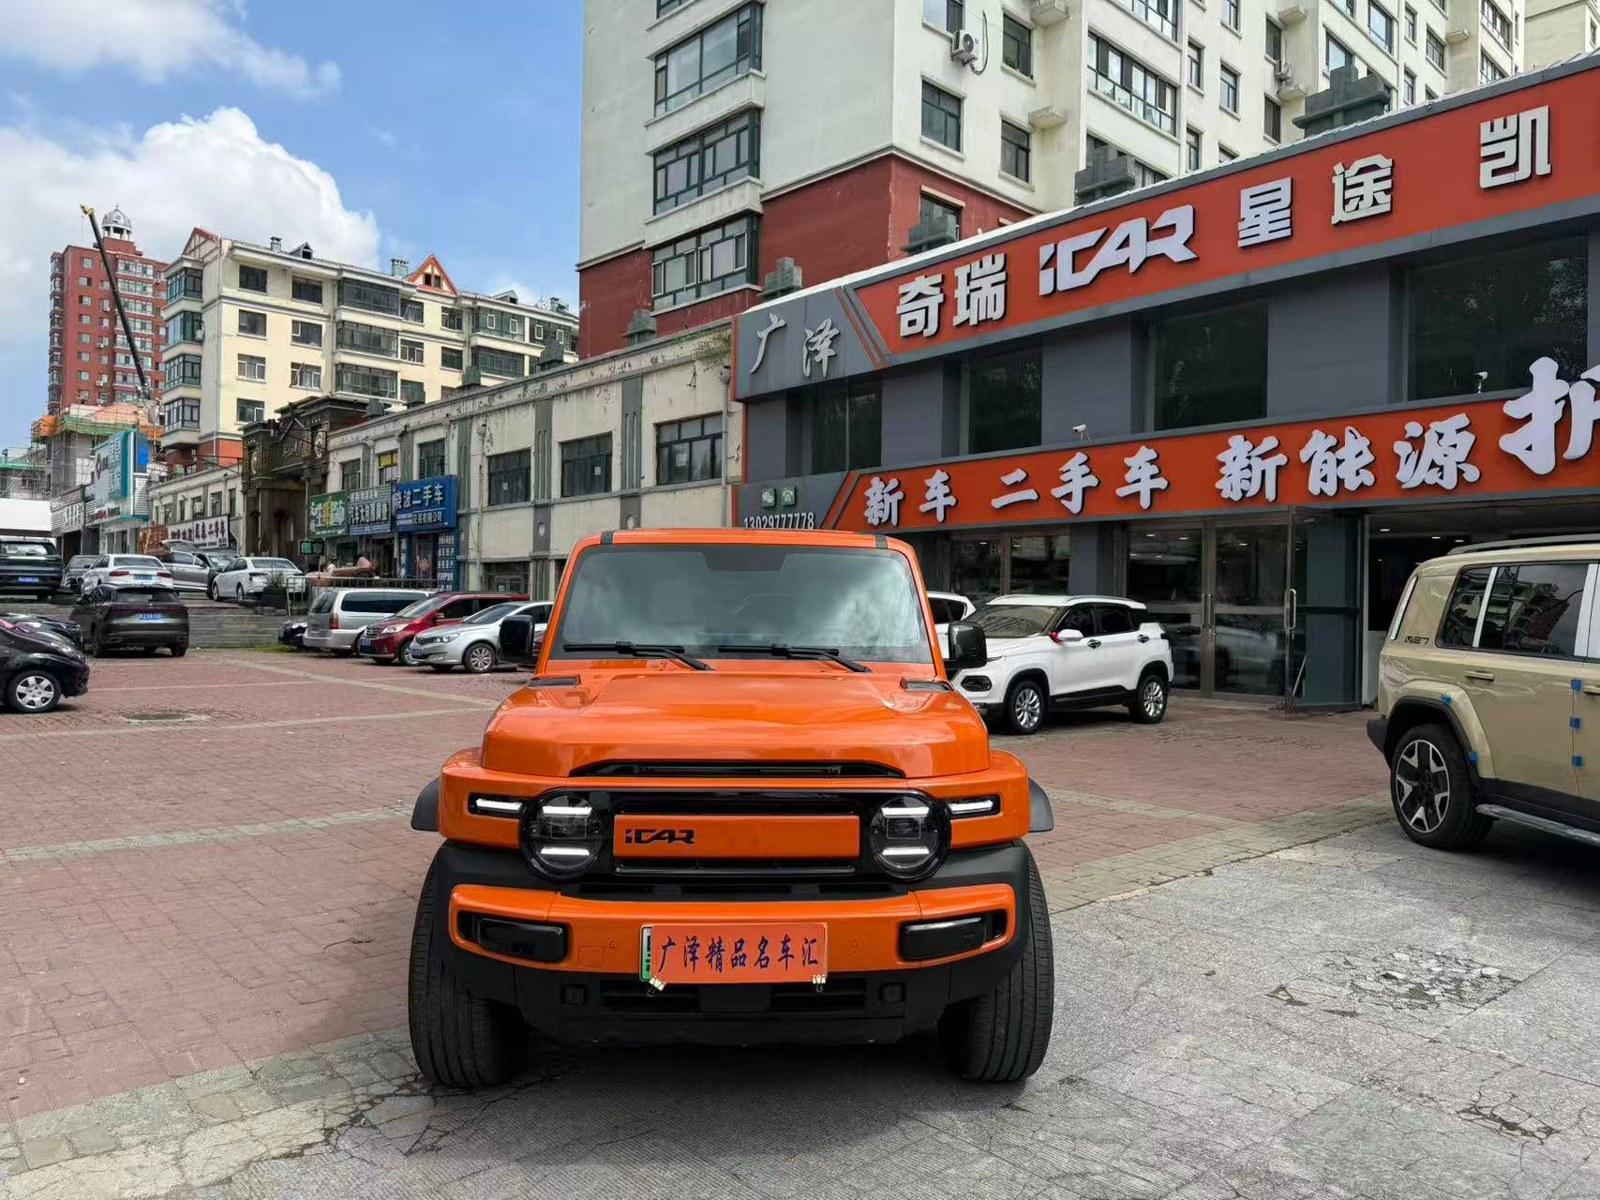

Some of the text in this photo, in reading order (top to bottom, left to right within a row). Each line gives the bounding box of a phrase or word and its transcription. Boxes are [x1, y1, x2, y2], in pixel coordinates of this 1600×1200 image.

[896, 253, 1007, 338] 奇瑞
[1038, 204, 1197, 296] iCAR
[1478, 105, 1551, 190] 凯
[751, 313, 840, 377] 广泽
[864, 471, 957, 527] 新车
[991, 445, 1169, 515] 二手车
[1215, 414, 1481, 502] 新能源
[744, 512, 815, 530] 13029777778
[625, 829, 695, 844] iCAR
[658, 934, 819, 973] 广泽精品名车汇
